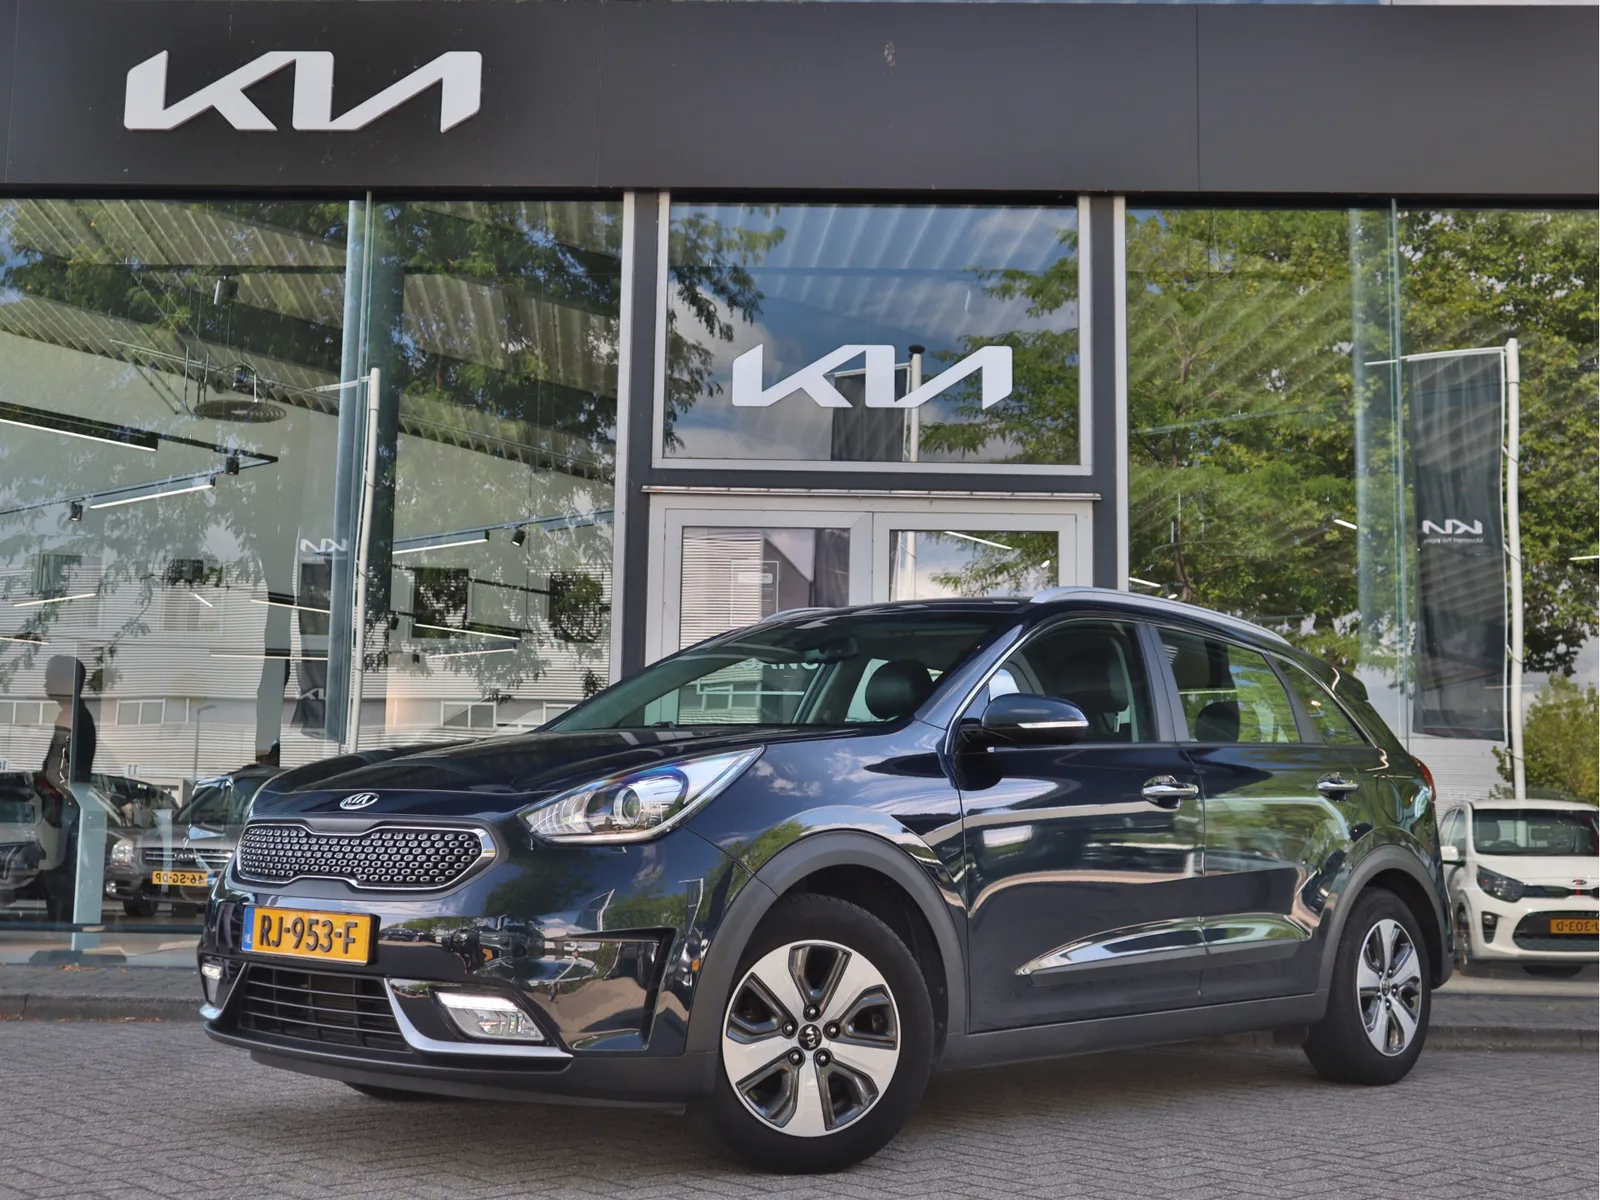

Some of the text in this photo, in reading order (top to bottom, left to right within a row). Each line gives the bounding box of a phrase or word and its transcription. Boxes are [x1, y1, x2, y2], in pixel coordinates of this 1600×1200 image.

[123, 49, 483, 134] KIA
[731, 343, 1013, 410] KIA
[341, 793, 373, 807] KIA
[259, 914, 358, 955] RJ-953-F
[805, 1026, 816, 1048] KIA
